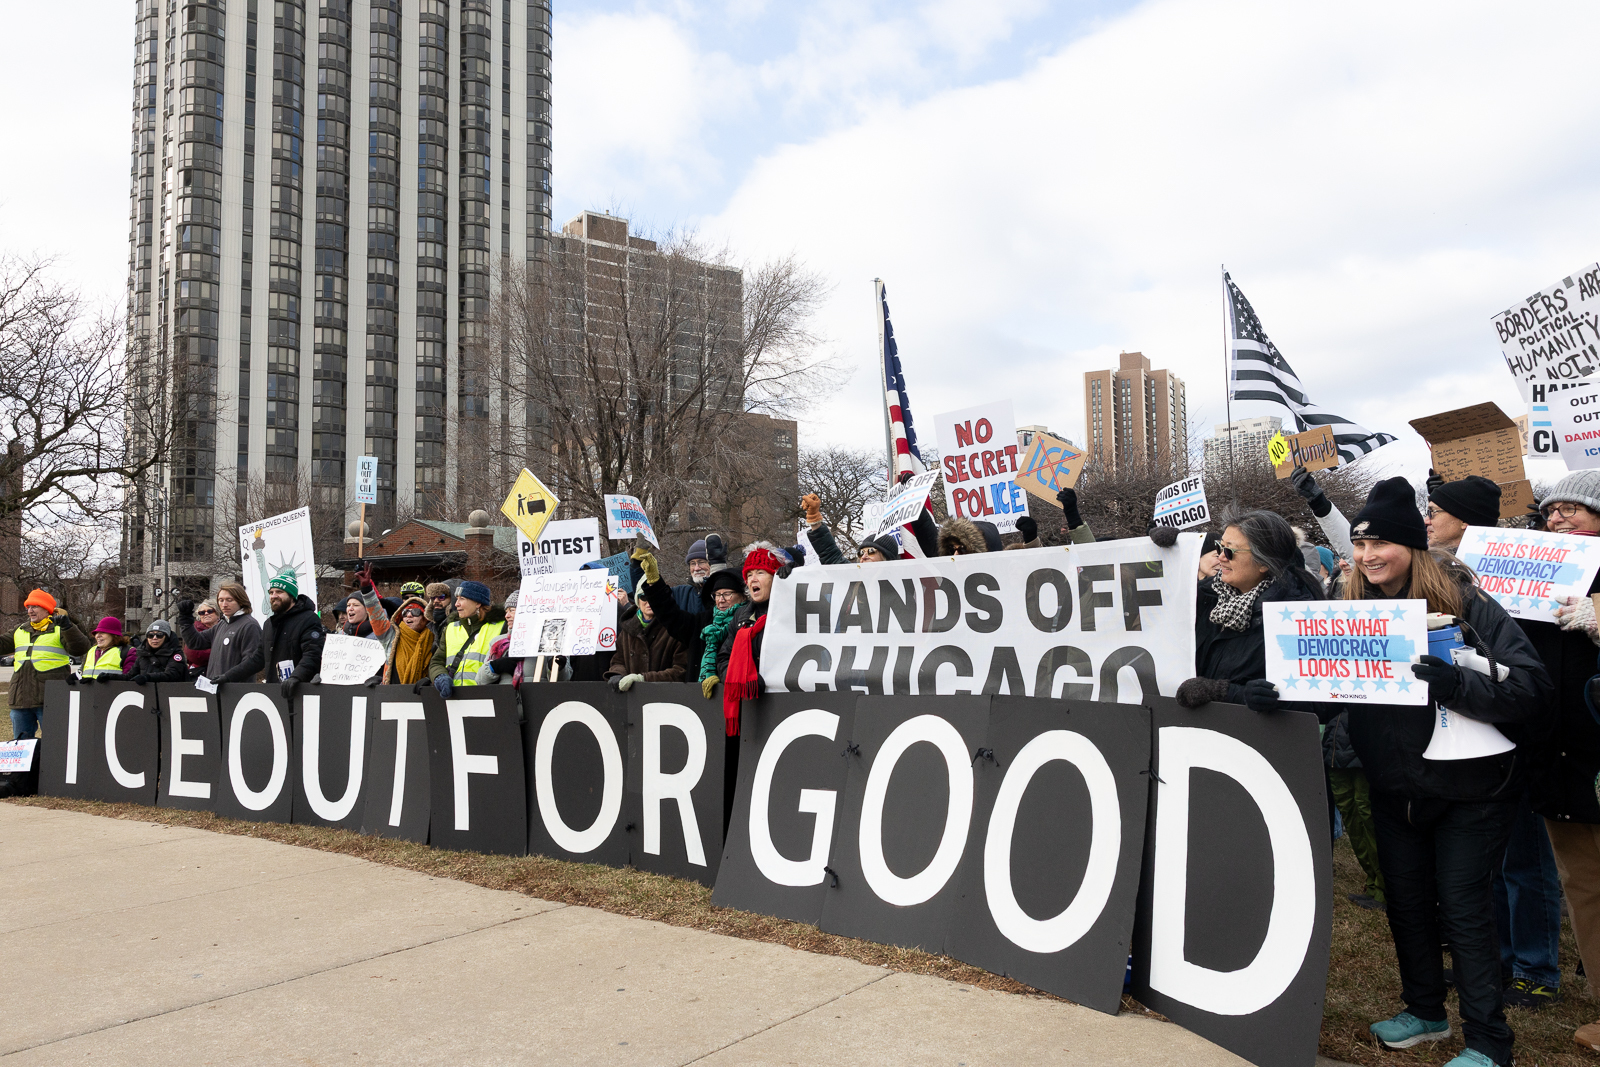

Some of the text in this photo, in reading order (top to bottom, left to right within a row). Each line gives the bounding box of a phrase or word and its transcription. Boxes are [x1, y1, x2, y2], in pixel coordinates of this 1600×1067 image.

[1496, 288, 1568, 343] BORDERS
[1508, 315, 1600, 376] HUMANITY
[1570, 394, 1598, 406] OUT
[1574, 411, 1600, 424] OUT
[954, 418, 993, 448] NO
[1271, 441, 1284, 461] NO
[1289, 434, 1335, 468] Humpty
[362, 462, 372, 470] ICE
[944, 444, 1018, 484] SECRET
[1026, 439, 1076, 492] ICE
[914, 472, 936, 487] OFF
[1182, 478, 1199, 492] OFF
[952, 480, 1025, 518] POLICE
[242, 510, 306, 534] OUR BELOVED QUEENS
[622, 520, 642, 528] LOOKS
[878, 502, 922, 534] CHICAGO
[1154, 505, 1206, 527] CHICAGO
[242, 539, 249, 550] Q
[1484, 542, 1571, 564] THIS IS WHAT
[522, 556, 548, 566] CAUTION
[533, 566, 552, 575] AHEAD
[1476, 558, 1562, 580] DEMOCRACY
[1473, 575, 1555, 598] OOKS LIKE
[590, 595, 596, 604] 3
[795, 560, 1164, 634] HANDS OFF
[518, 605, 536, 614] ICE
[575, 627, 594, 636] OUT
[578, 618, 593, 628] ICE
[1295, 618, 1389, 636] THIS IS WHAT
[513, 630, 527, 640] OUT
[572, 644, 595, 656] GOOD
[1297, 638, 1389, 657] DEMOCRACY
[322, 662, 373, 672] extra racist
[356, 654, 371, 664] ego
[1298, 658, 1394, 678] LOOKS LIKE
[784, 644, 1161, 704] CHICAGO
[66, 691, 1315, 1015] ICE OUT FOR GOOD
